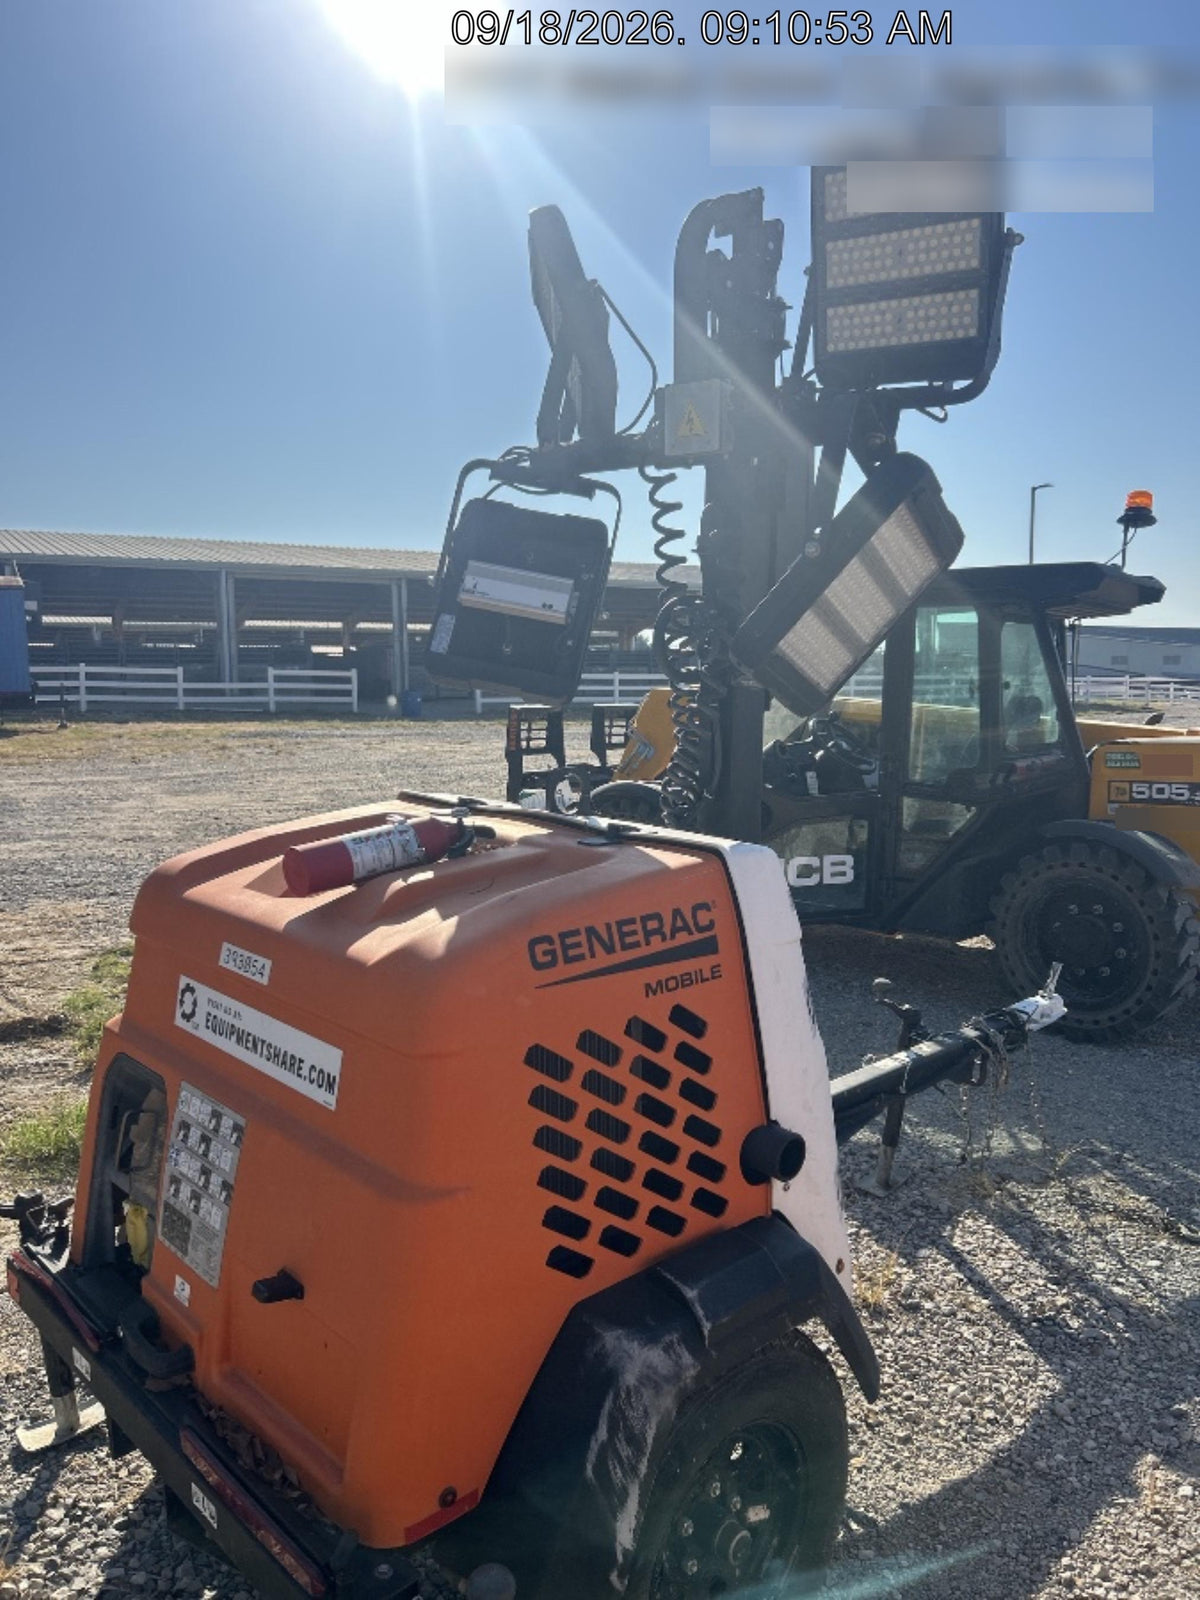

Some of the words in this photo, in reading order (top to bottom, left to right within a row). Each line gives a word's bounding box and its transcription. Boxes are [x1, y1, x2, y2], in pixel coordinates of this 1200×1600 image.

[780, 854, 855, 888] CB
[527, 902, 716, 971] GENERAC
[643, 963, 723, 999] MOBILE
[205, 1011, 337, 1096] EQUIPMENTSHARE.COM
